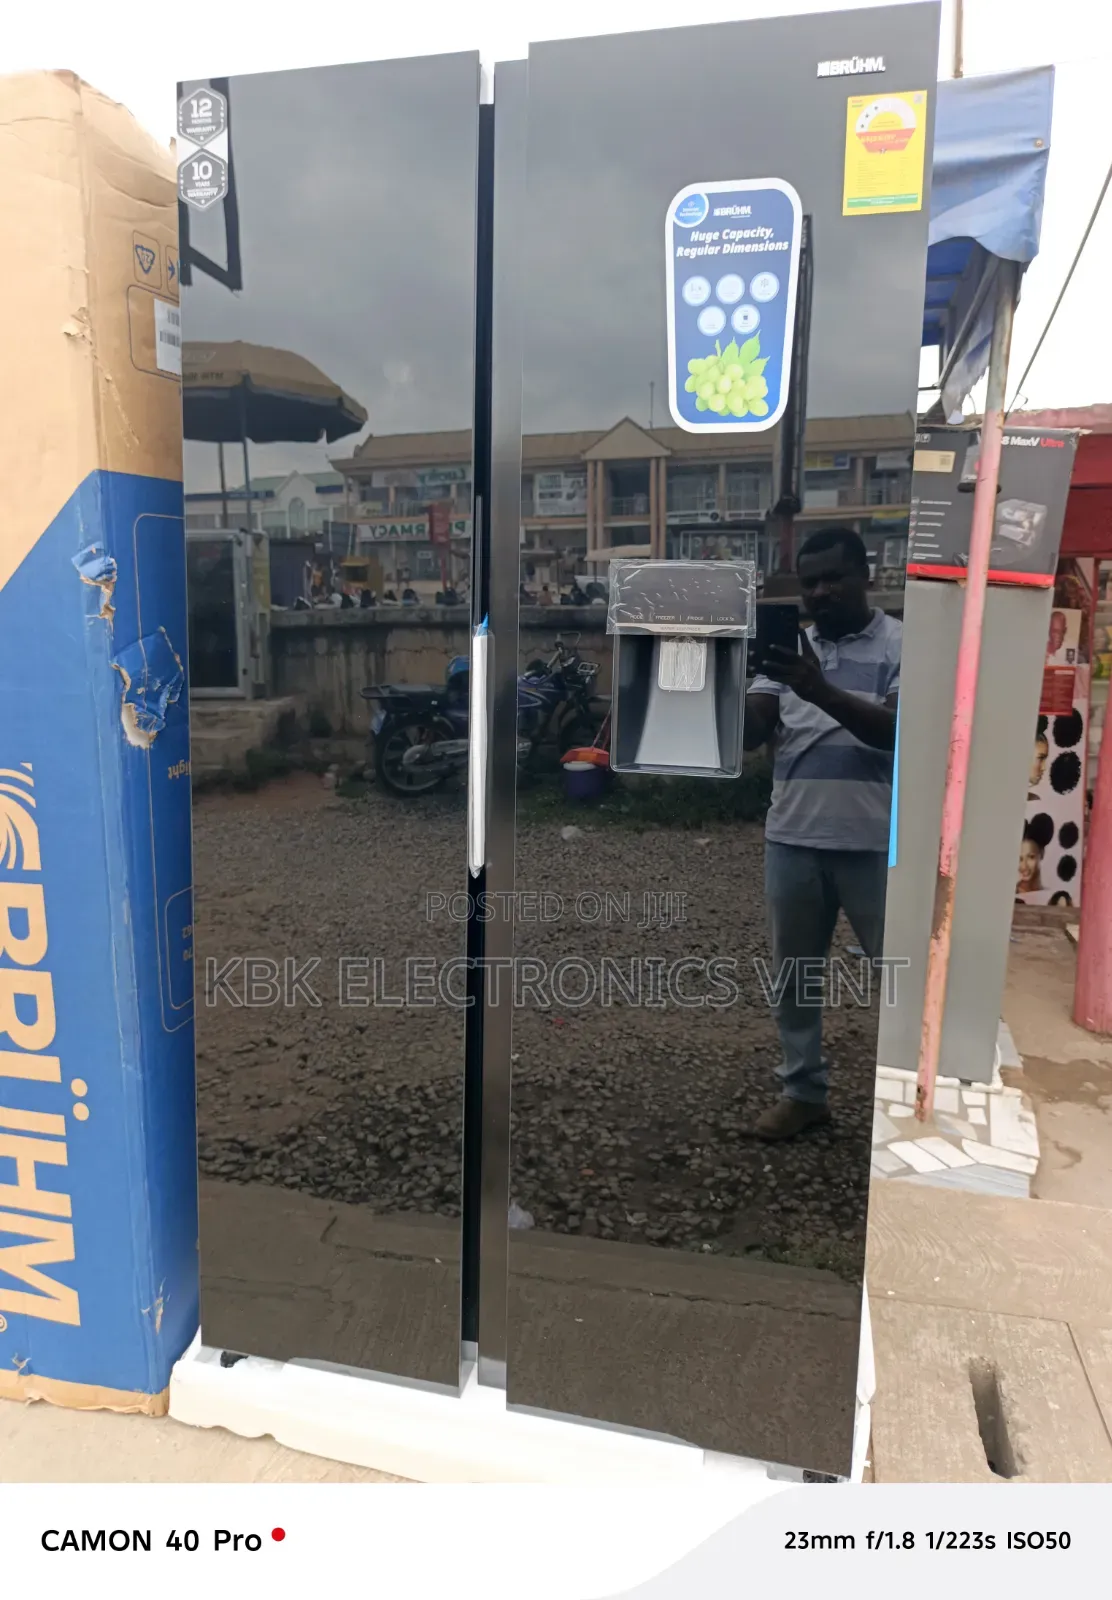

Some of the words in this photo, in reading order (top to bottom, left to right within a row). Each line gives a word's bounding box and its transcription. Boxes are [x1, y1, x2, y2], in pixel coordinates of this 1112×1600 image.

[190, 98, 213, 118] 12
[191, 160, 213, 180] 10
[690, 230, 720, 244] Huge
[721, 226, 774, 242] Capacity,
[676, 244, 721, 259] Regular
[722, 240, 789, 255] Dimensions
[1009, 436, 1041, 447] MaxV
[1040, 437, 1065, 448] Ultra
[0, 881, 90, 1327] BRÜHM
